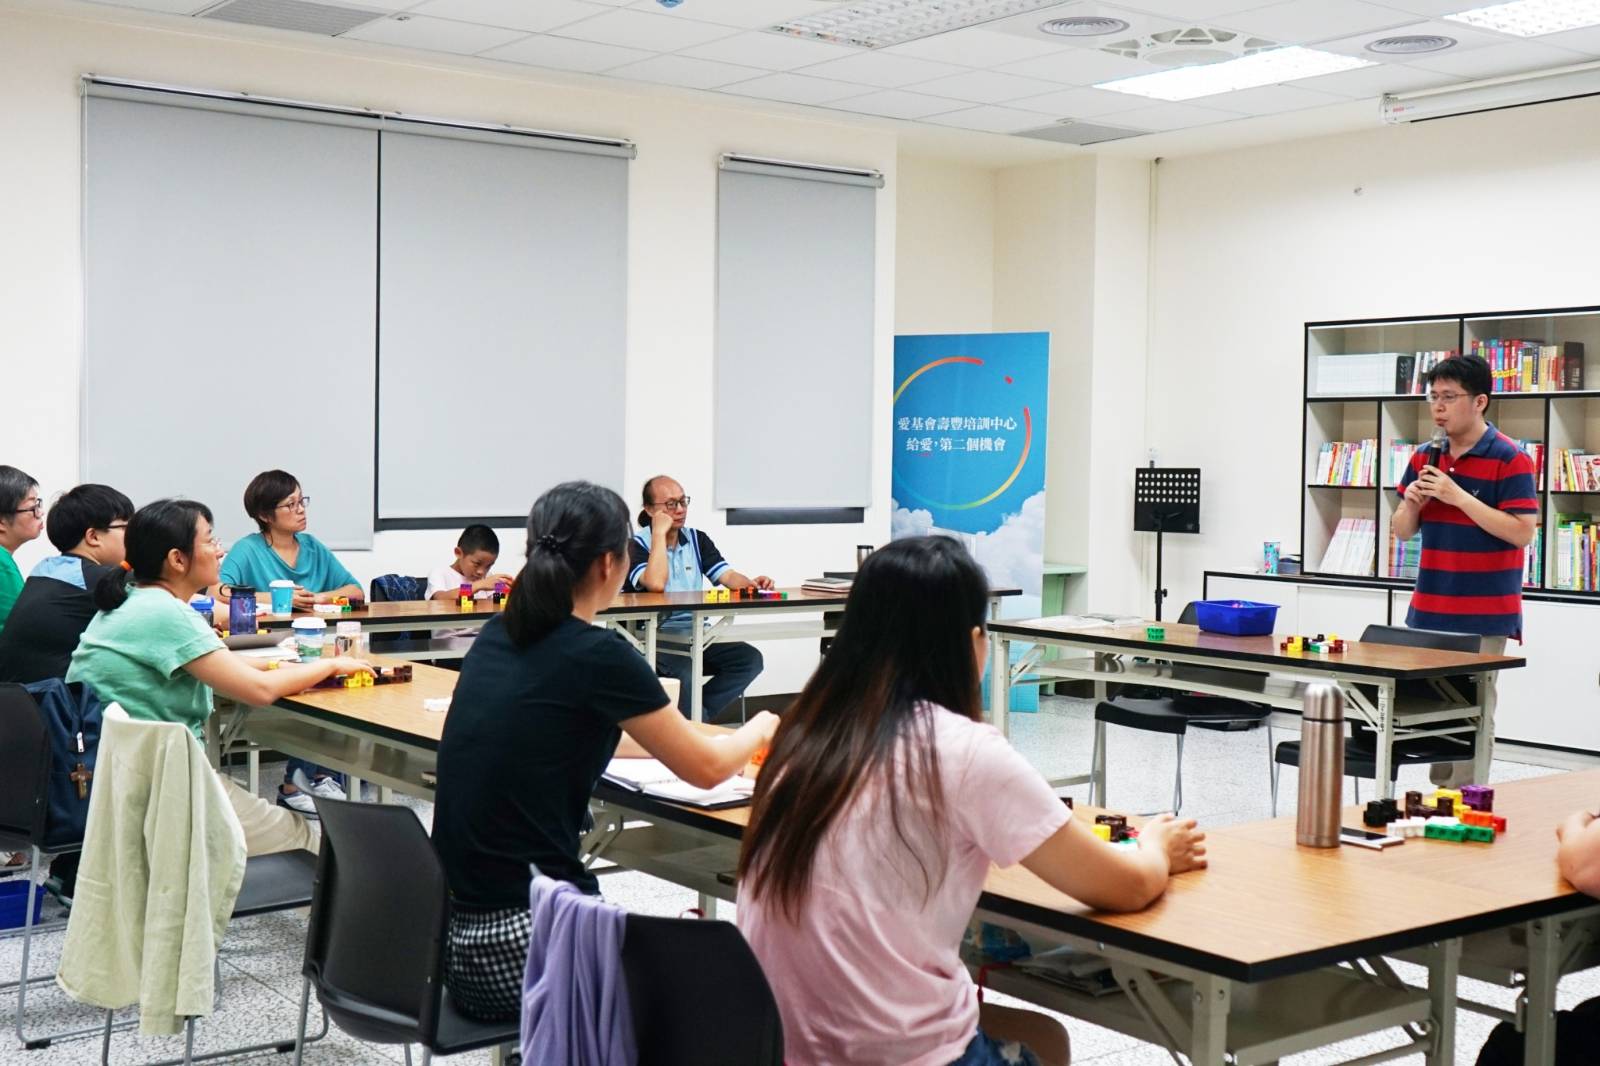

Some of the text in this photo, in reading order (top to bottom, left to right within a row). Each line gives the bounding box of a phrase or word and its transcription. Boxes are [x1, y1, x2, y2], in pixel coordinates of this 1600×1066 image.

[898, 416, 1017, 430] 愛基會壽豐培訓中心
